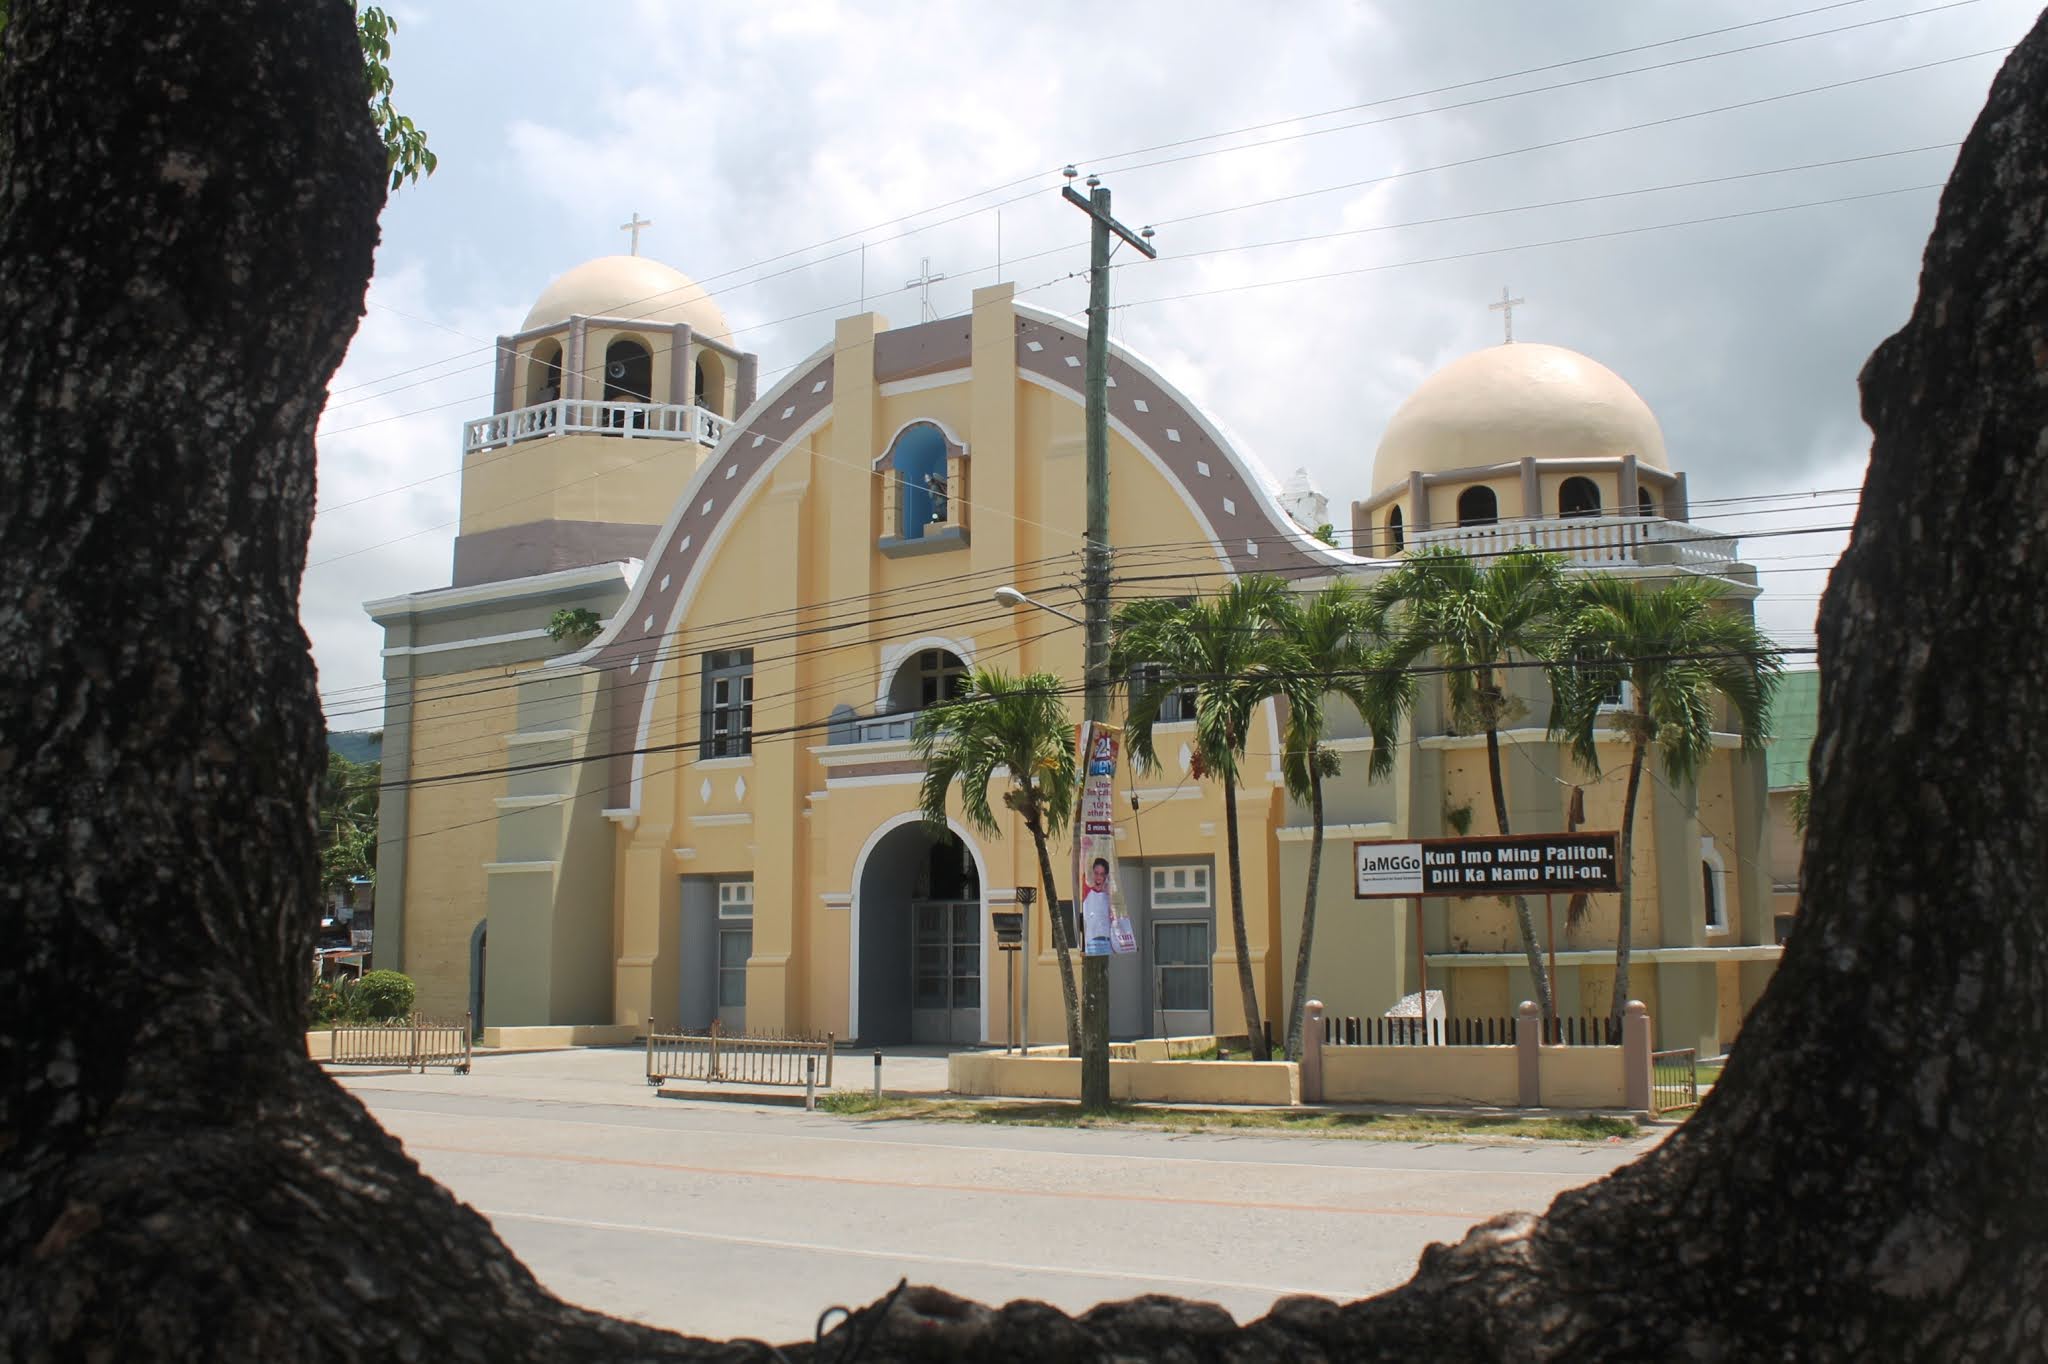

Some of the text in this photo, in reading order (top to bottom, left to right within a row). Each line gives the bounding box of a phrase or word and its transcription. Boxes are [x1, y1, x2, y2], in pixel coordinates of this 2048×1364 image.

[1362, 856, 1421, 871] JaMGGo
[1425, 851, 1456, 865] Kun
[1461, 850, 1492, 864] Imo
[1497, 848, 1540, 863] Ming
[1432, 869, 1460, 884] Dili
[1465, 868, 1486, 882] Ka
[1491, 867, 1539, 881] Namo
[1544, 866, 1608, 880] Pili-on.
